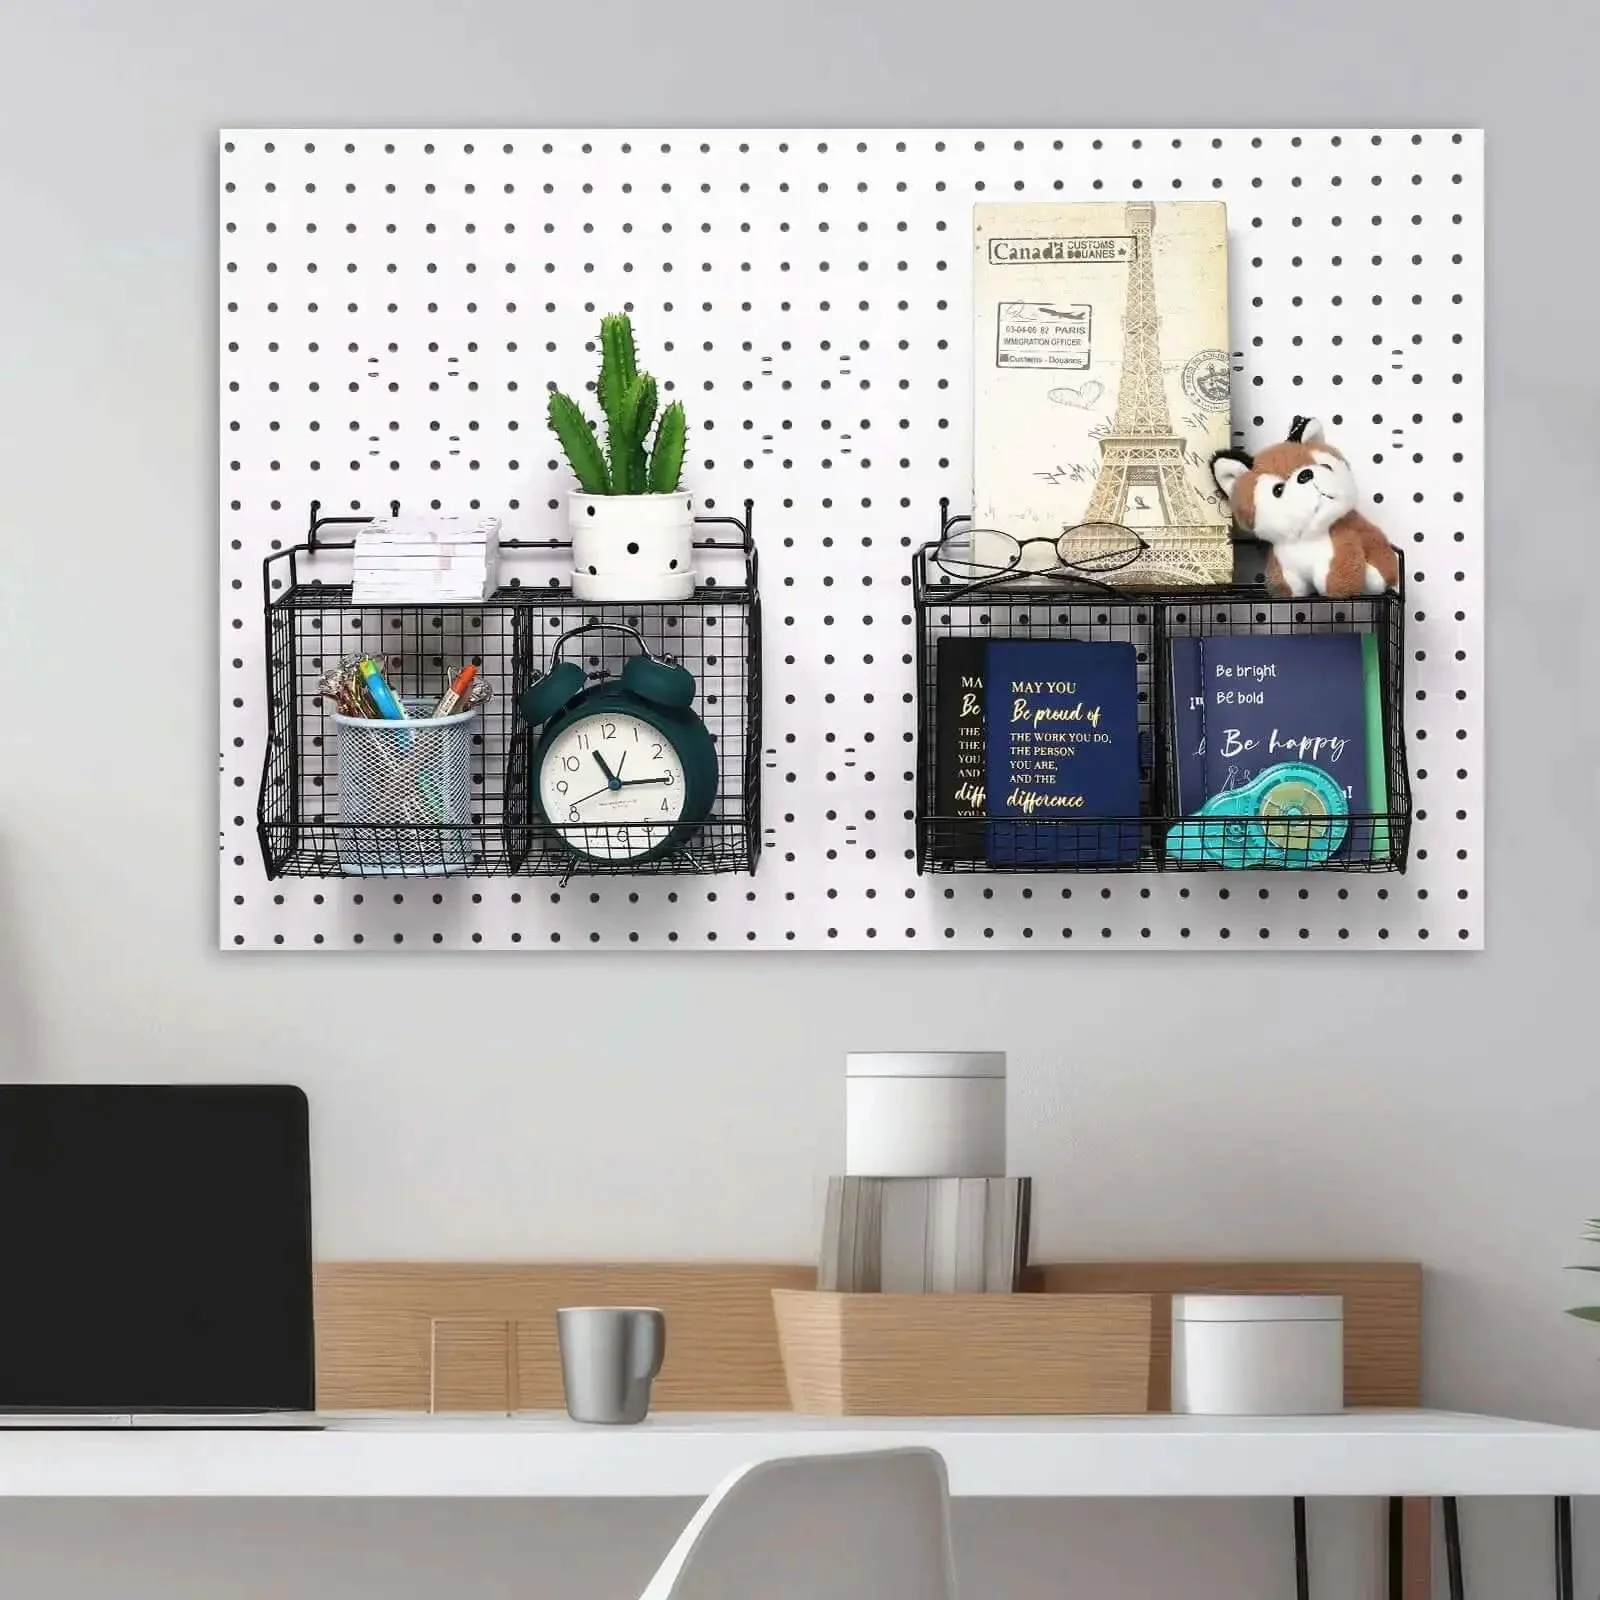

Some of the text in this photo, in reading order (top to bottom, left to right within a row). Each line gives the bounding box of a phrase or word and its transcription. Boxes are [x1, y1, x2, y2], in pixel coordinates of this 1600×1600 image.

[994, 242, 1064, 260] Canada
[1067, 240, 1115, 250] CUSTOMS
[1067, 249, 1115, 259] DOUANES
[1055, 326, 1086, 335] PARIS
[1003, 338, 1082, 346] IMMIGRATION OFFICER
[1216, 664, 1276, 682] Be bright
[961, 676, 984, 689] MA
[1011, 681, 1076, 694] MAY YOU
[1216, 691, 1233, 704] Be
[1238, 691, 1264, 704] bold
[1010, 698, 1101, 729] Be proud of
[601, 723, 616, 740] 12
[633, 727, 639, 742] 1
[959, 727, 981, 737] THE
[578, 734, 589, 750] 11
[1010, 733, 1112, 744] THE WORK YOU DO,
[651, 743, 663, 759] 2
[959, 741, 980, 750] THE
[1010, 746, 1075, 756] THE PERSON
[1220, 729, 1259, 757] Be
[1269, 729, 1351, 762] happy
[562, 756, 580, 772] 10
[958, 755, 981, 764] YOU
[1009, 761, 1058, 771] YOU ARE,
[664, 770, 674, 785] 3
[958, 768, 980, 778] AND
[1009, 775, 1056, 784] AND THE
[556, 780, 568, 795] 9
[661, 798, 669, 812] 4
[1007, 788, 1085, 814] difference
[568, 805, 580, 822] 8
